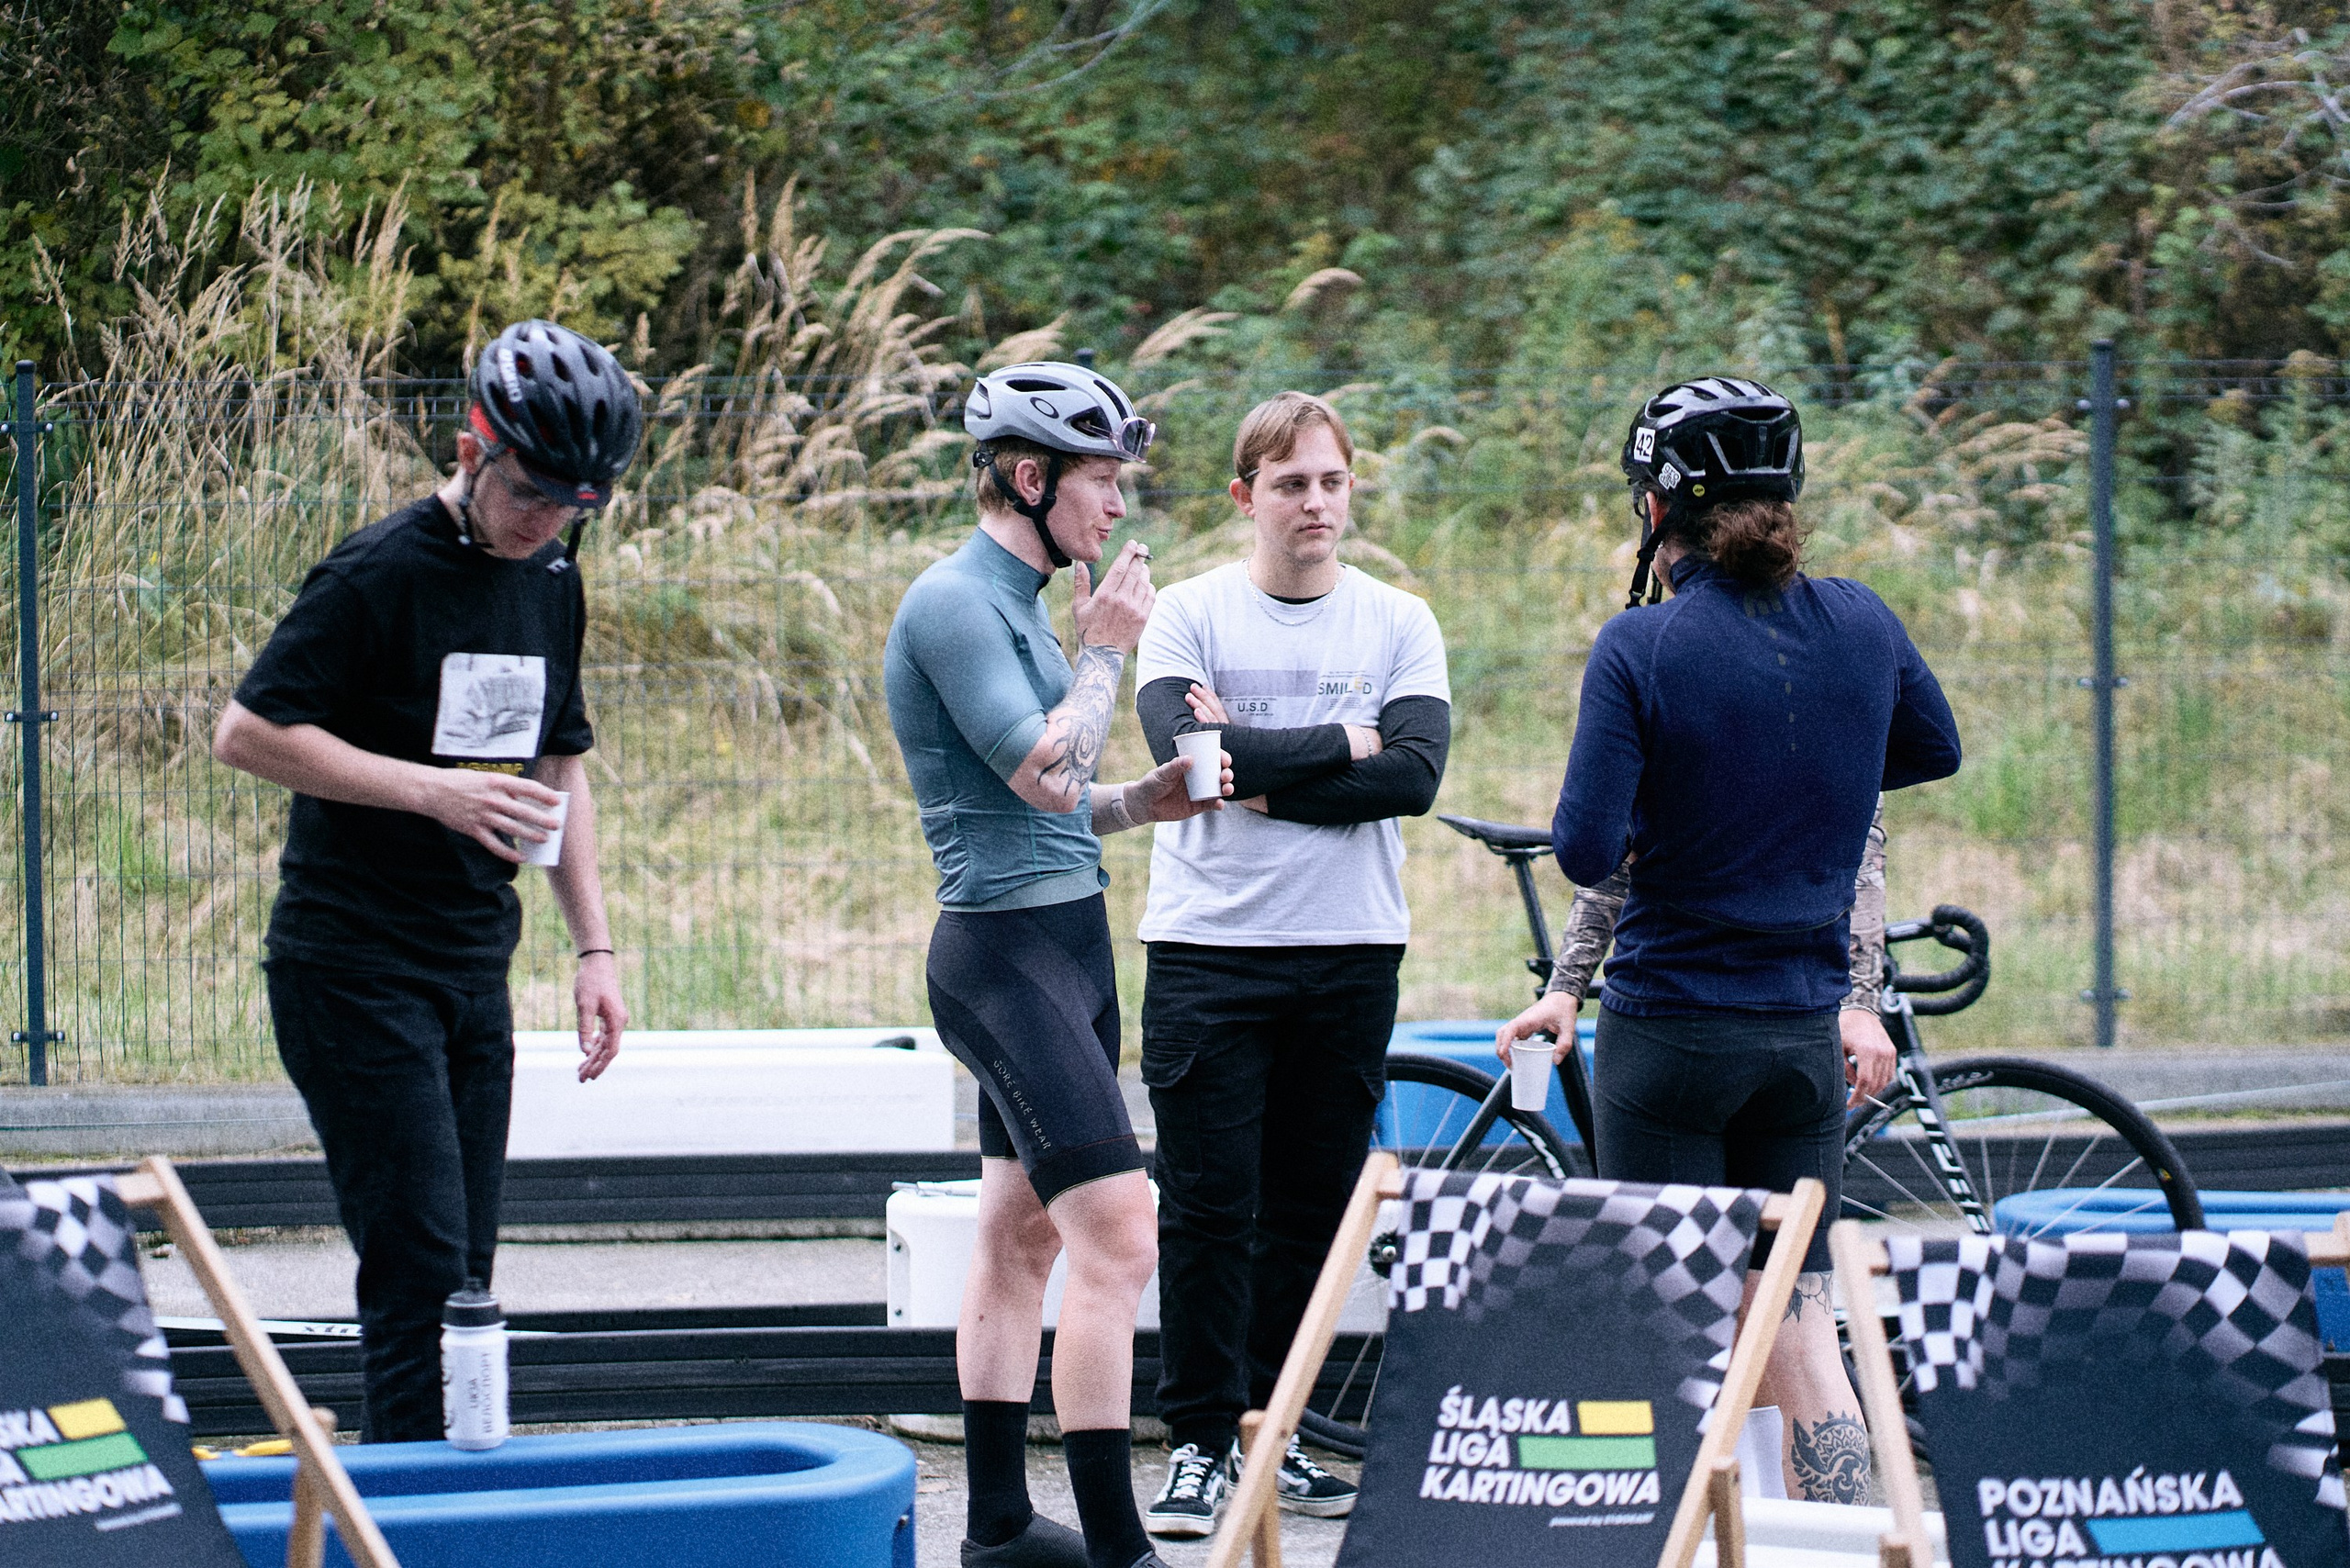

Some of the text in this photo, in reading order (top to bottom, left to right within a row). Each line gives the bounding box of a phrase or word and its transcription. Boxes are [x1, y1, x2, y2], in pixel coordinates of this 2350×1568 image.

[1636, 432, 1653, 457] 42
[1318, 677, 1373, 695] SMILED
[1237, 702, 1269, 712] U.S.D
[993, 1059, 1051, 1149] GORE BIKE WEAR
[1437, 1384, 1572, 1439] ŚLĄSKA
[1428, 1430, 1511, 1469] LIGA
[1419, 1466, 1661, 1507] KARTINGOWA
[1977, 1463, 2244, 1517] POZNAŃSKA
[1984, 1518, 2087, 1558] LIGA
